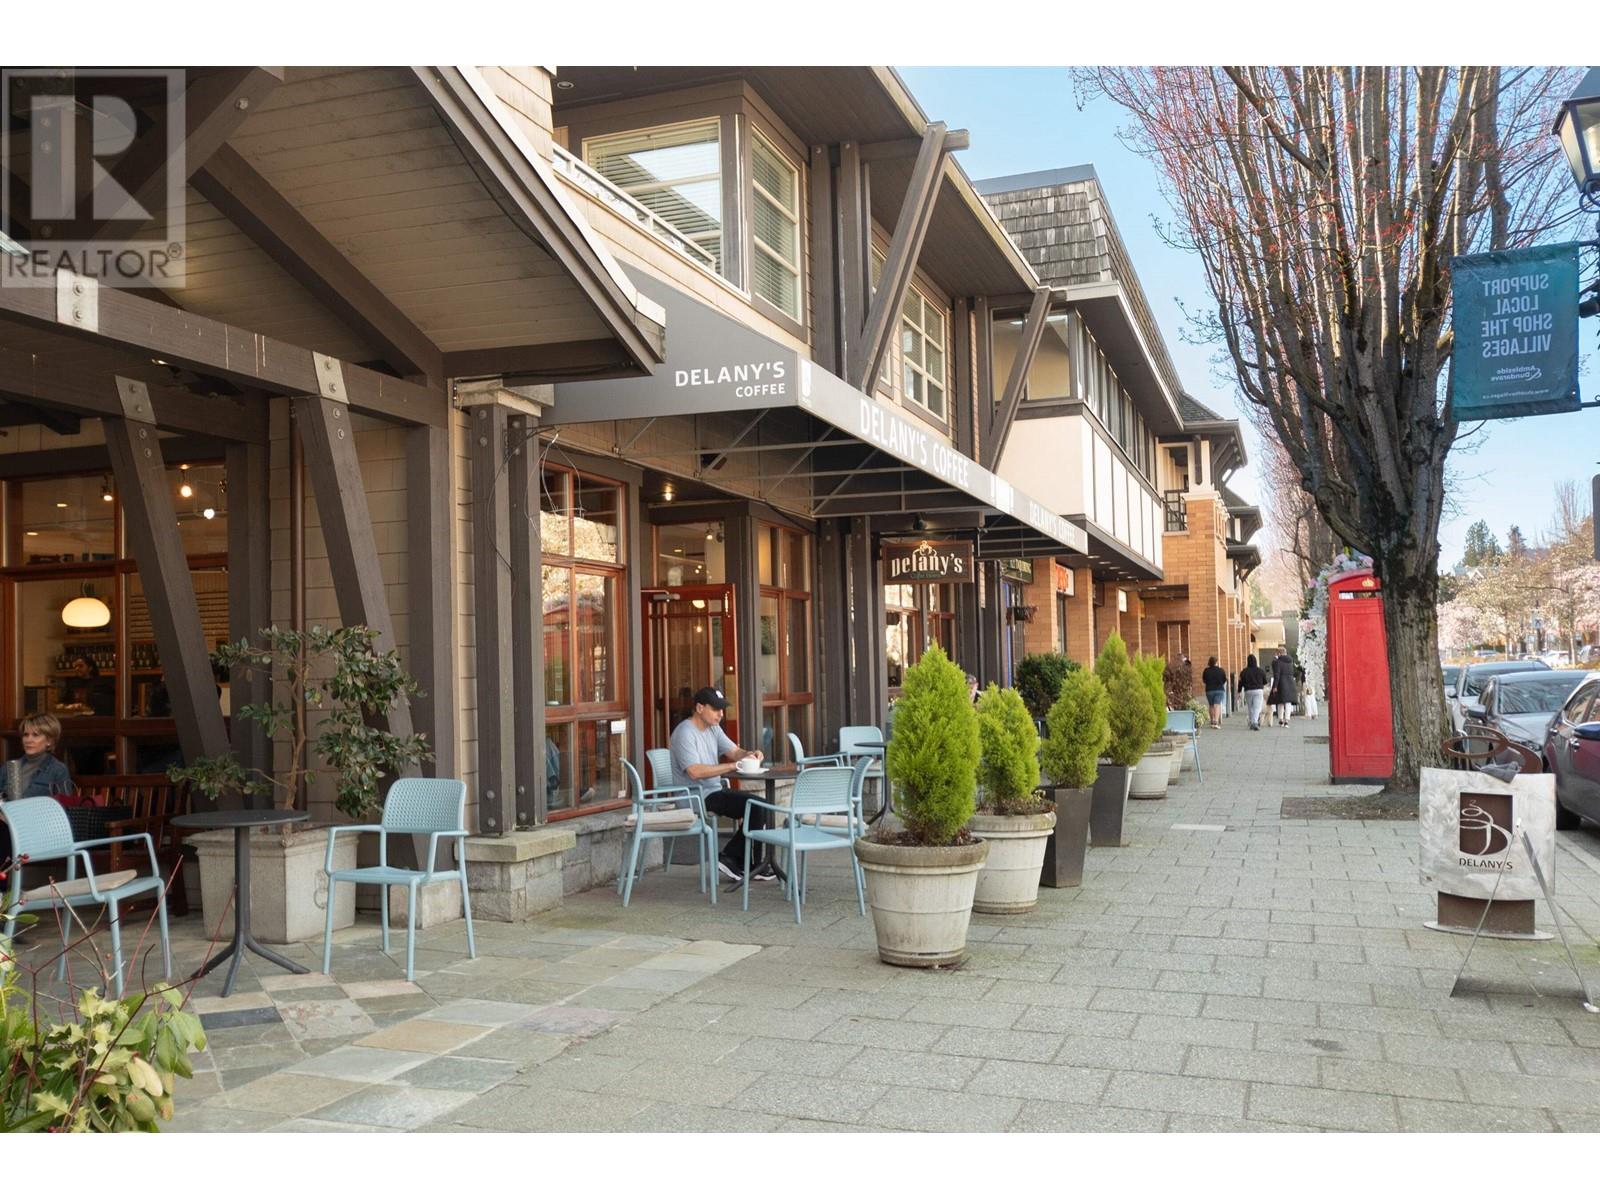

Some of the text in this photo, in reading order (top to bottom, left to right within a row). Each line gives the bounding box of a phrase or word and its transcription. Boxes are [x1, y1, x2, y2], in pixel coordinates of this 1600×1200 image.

[675, 360, 786, 387] DELANY'S
[735, 382, 786, 398] COFFEE
[860, 398, 970, 489] DELANY'S COFFEE
